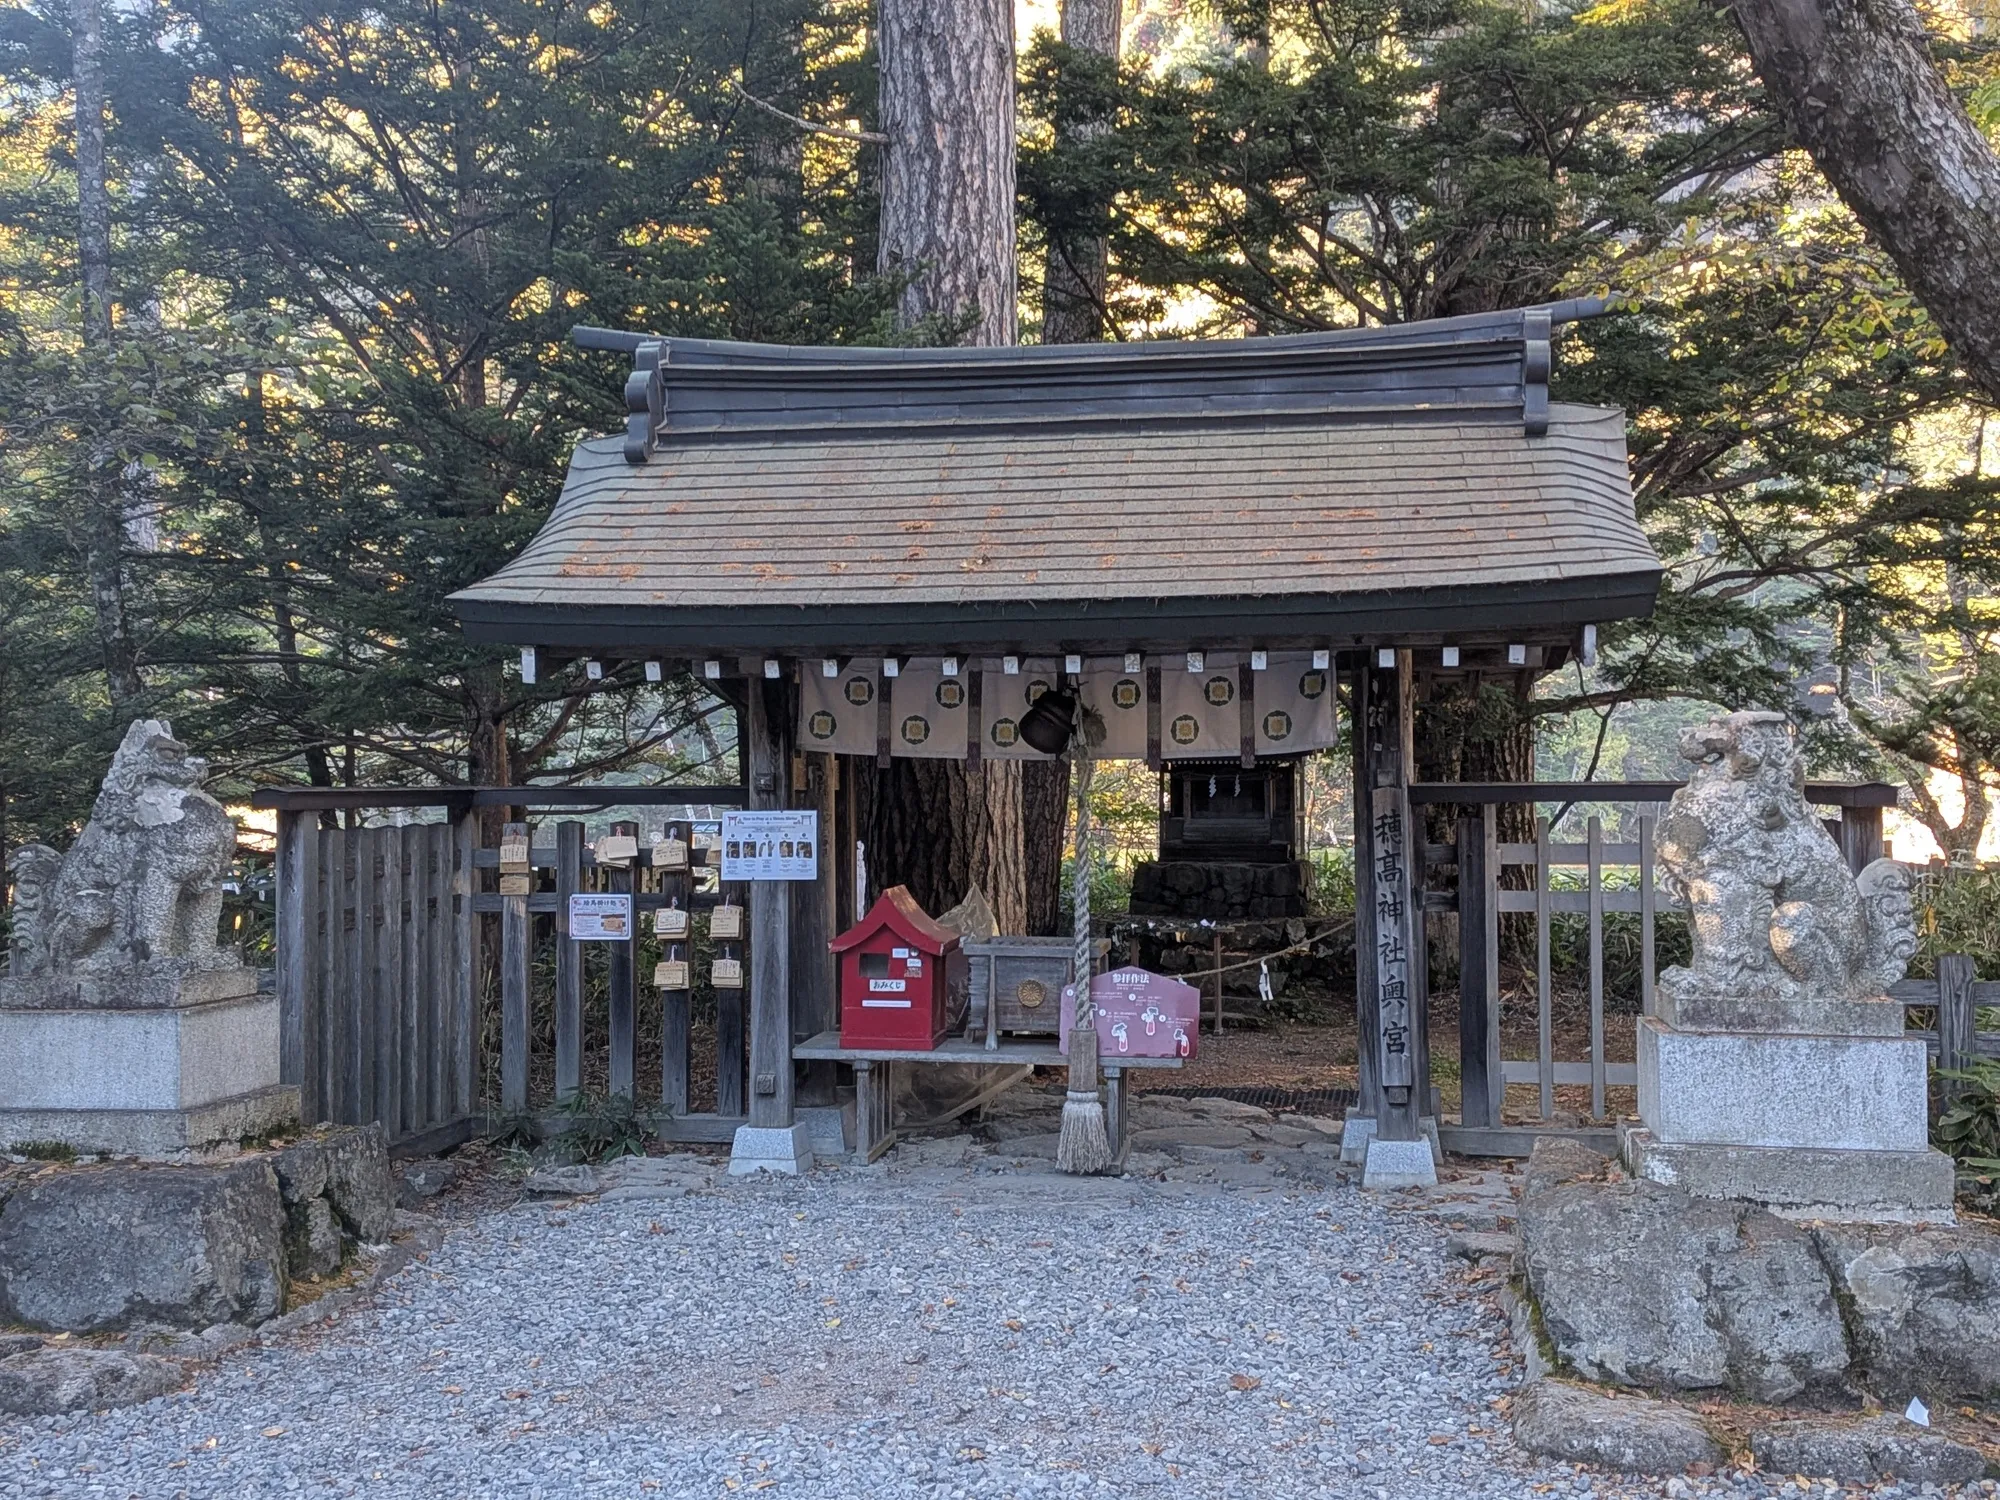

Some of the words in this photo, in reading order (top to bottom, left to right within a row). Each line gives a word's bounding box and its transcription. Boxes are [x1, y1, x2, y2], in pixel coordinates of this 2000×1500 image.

[1112, 973, 1150, 984] 参拝作法
[873, 981, 902, 990] おみくじ
